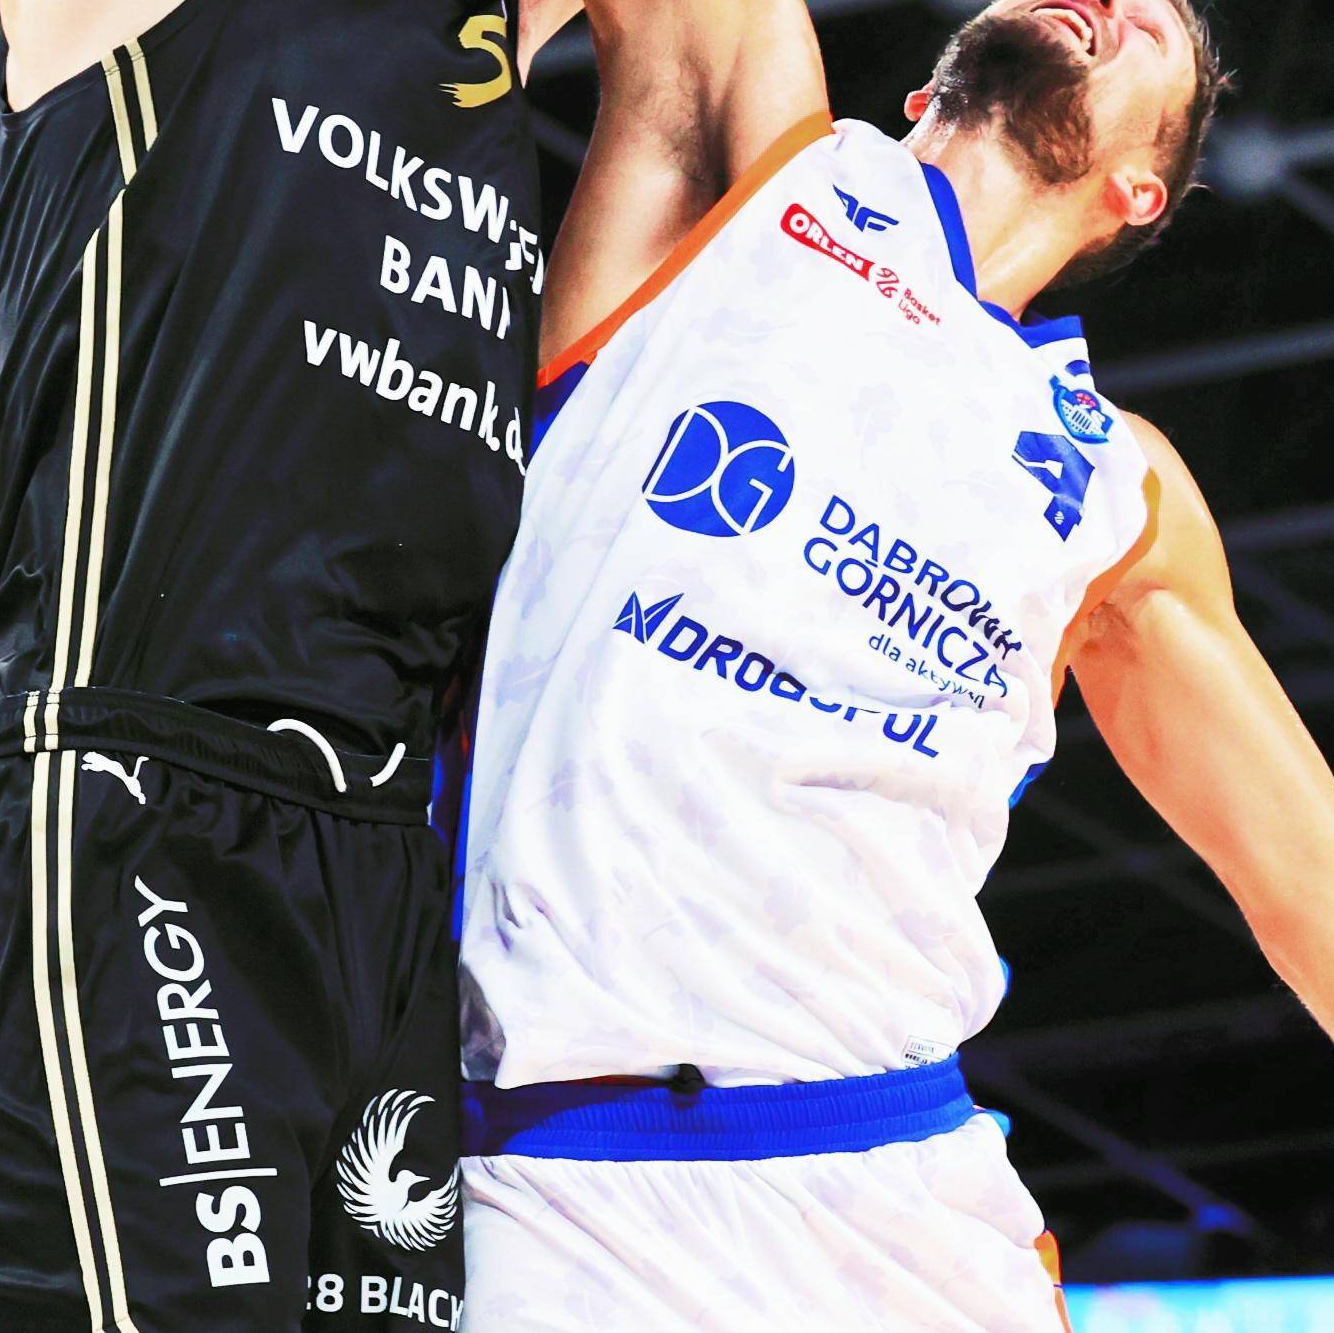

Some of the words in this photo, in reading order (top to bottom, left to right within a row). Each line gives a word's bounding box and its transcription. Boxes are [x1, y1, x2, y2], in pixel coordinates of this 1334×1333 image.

[438, 13, 513, 109] 5
[379, 234, 510, 341] BAN
[788, 212, 865, 272] ORLEN
[303, 320, 526, 476] vwbank.d
[868, 632, 902, 662] dla
